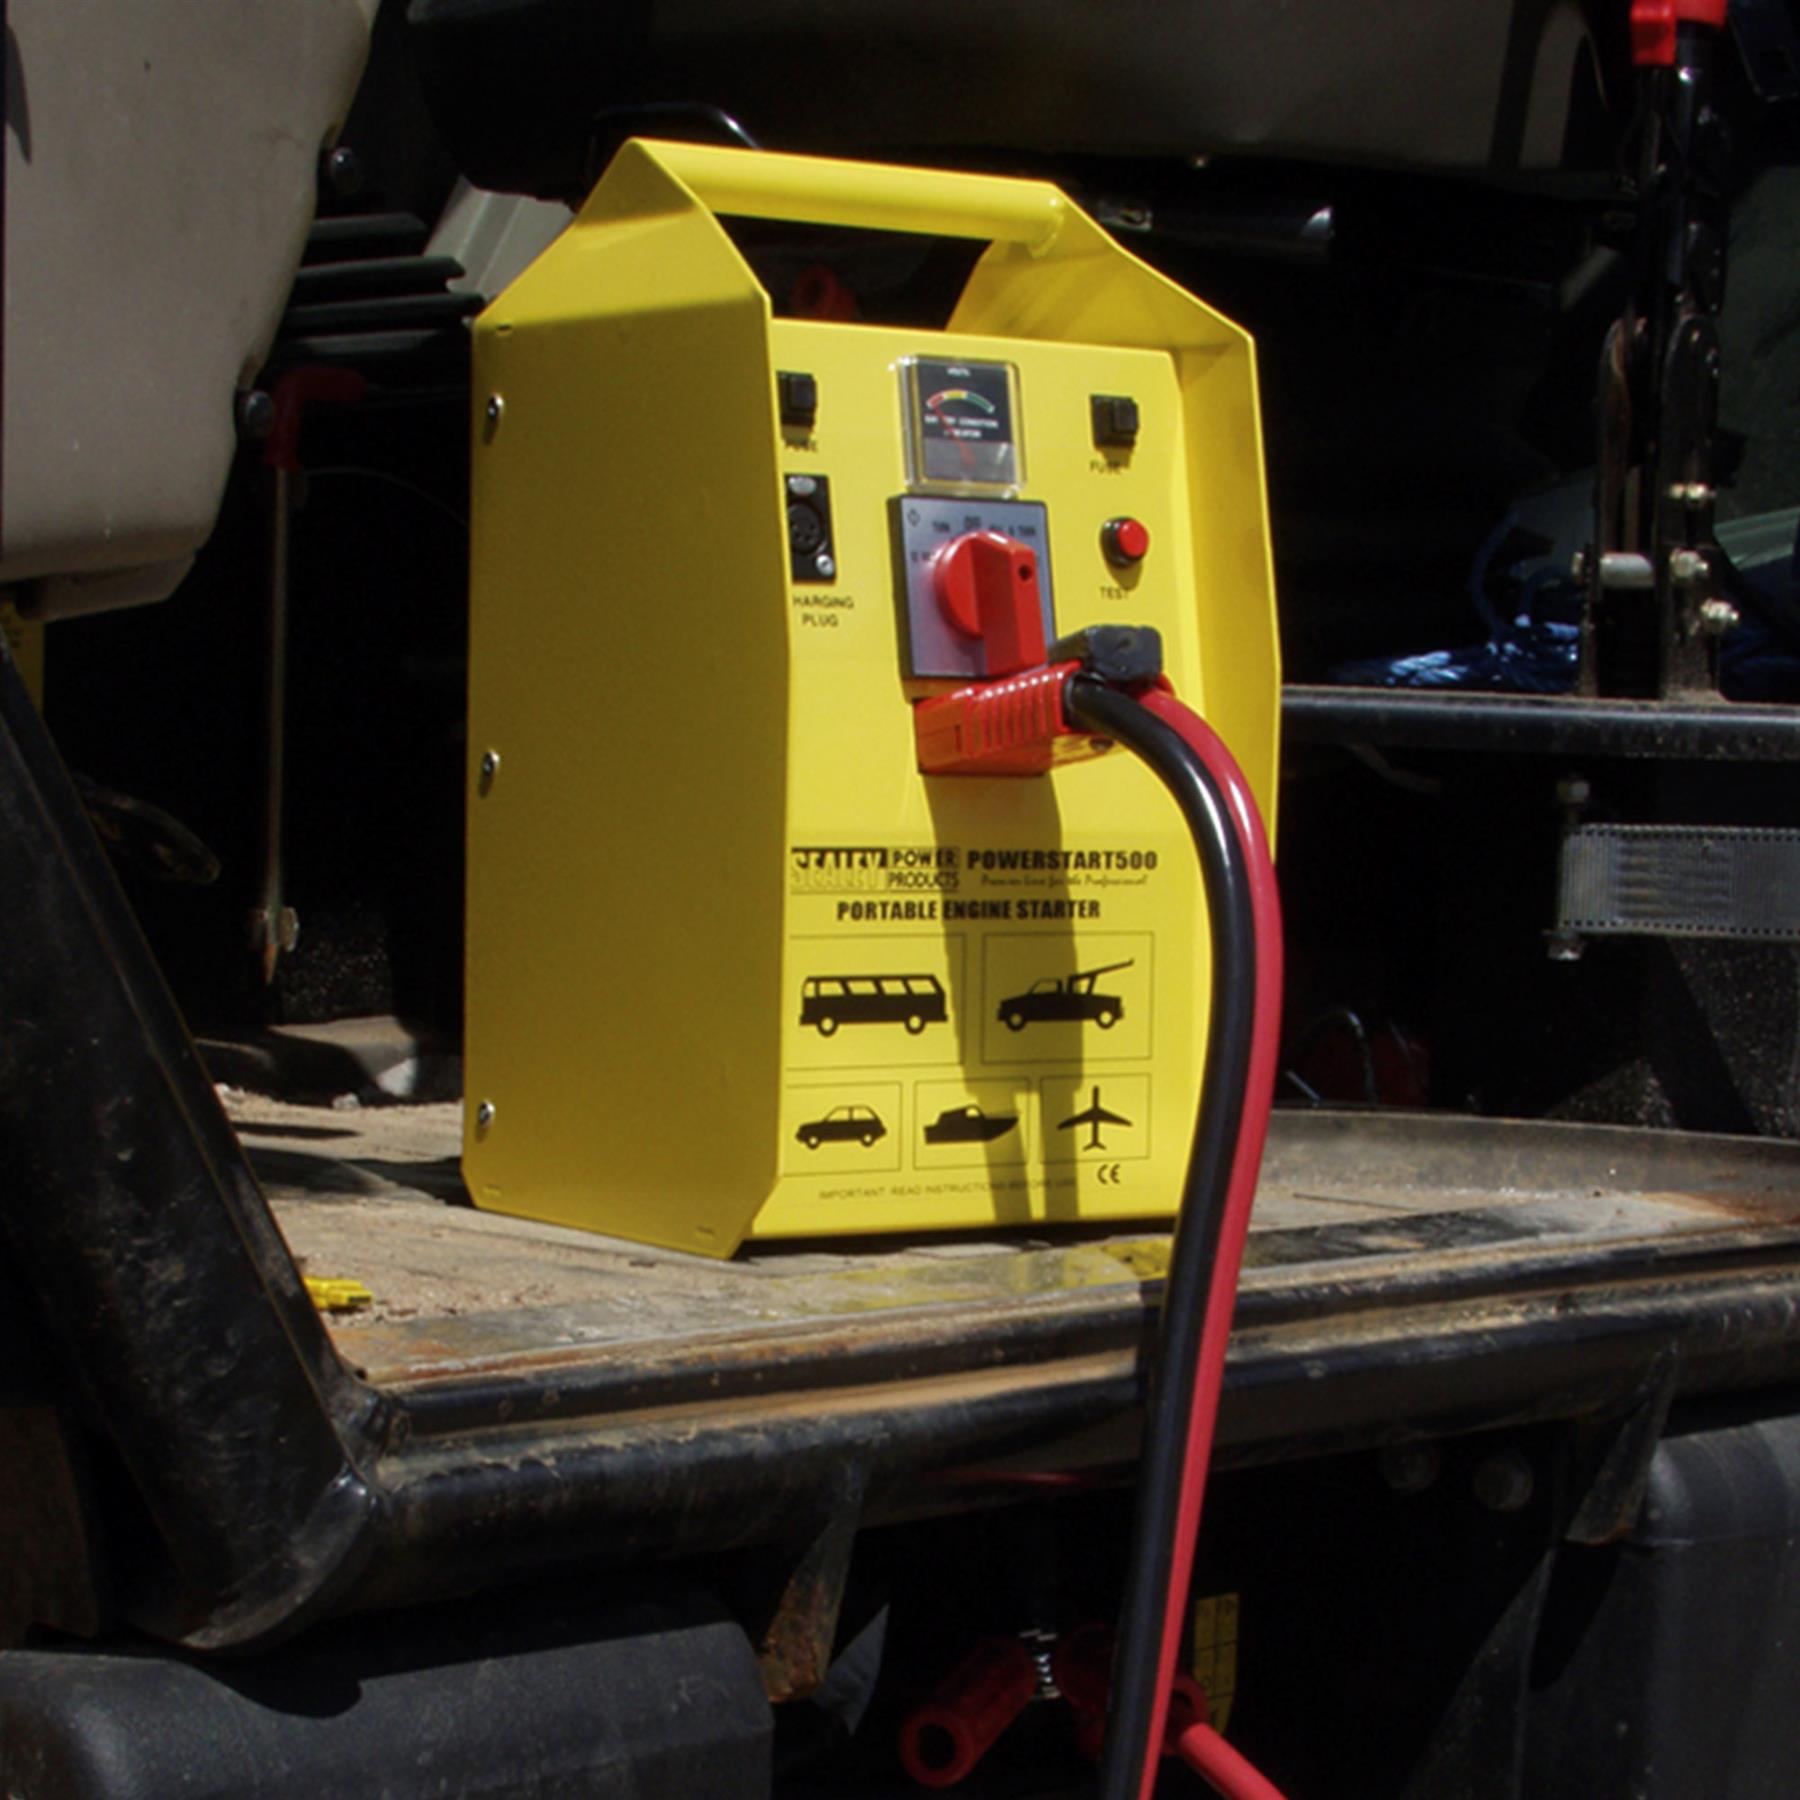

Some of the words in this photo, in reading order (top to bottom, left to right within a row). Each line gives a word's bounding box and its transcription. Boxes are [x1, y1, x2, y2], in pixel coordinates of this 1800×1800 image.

[1099, 586, 1130, 600] TEST
[792, 595, 855, 609] HARGING
[802, 613, 839, 627] PLUG
[893, 850, 957, 867] POWER
[968, 850, 1158, 870] POWERSTART500
[889, 870, 959, 888] PRODUCTS
[837, 901, 938, 921] PORTABLE
[943, 900, 1012, 920] ENGINE
[1016, 900, 1100, 919] STARTER
[890, 1185, 924, 1196] READ
